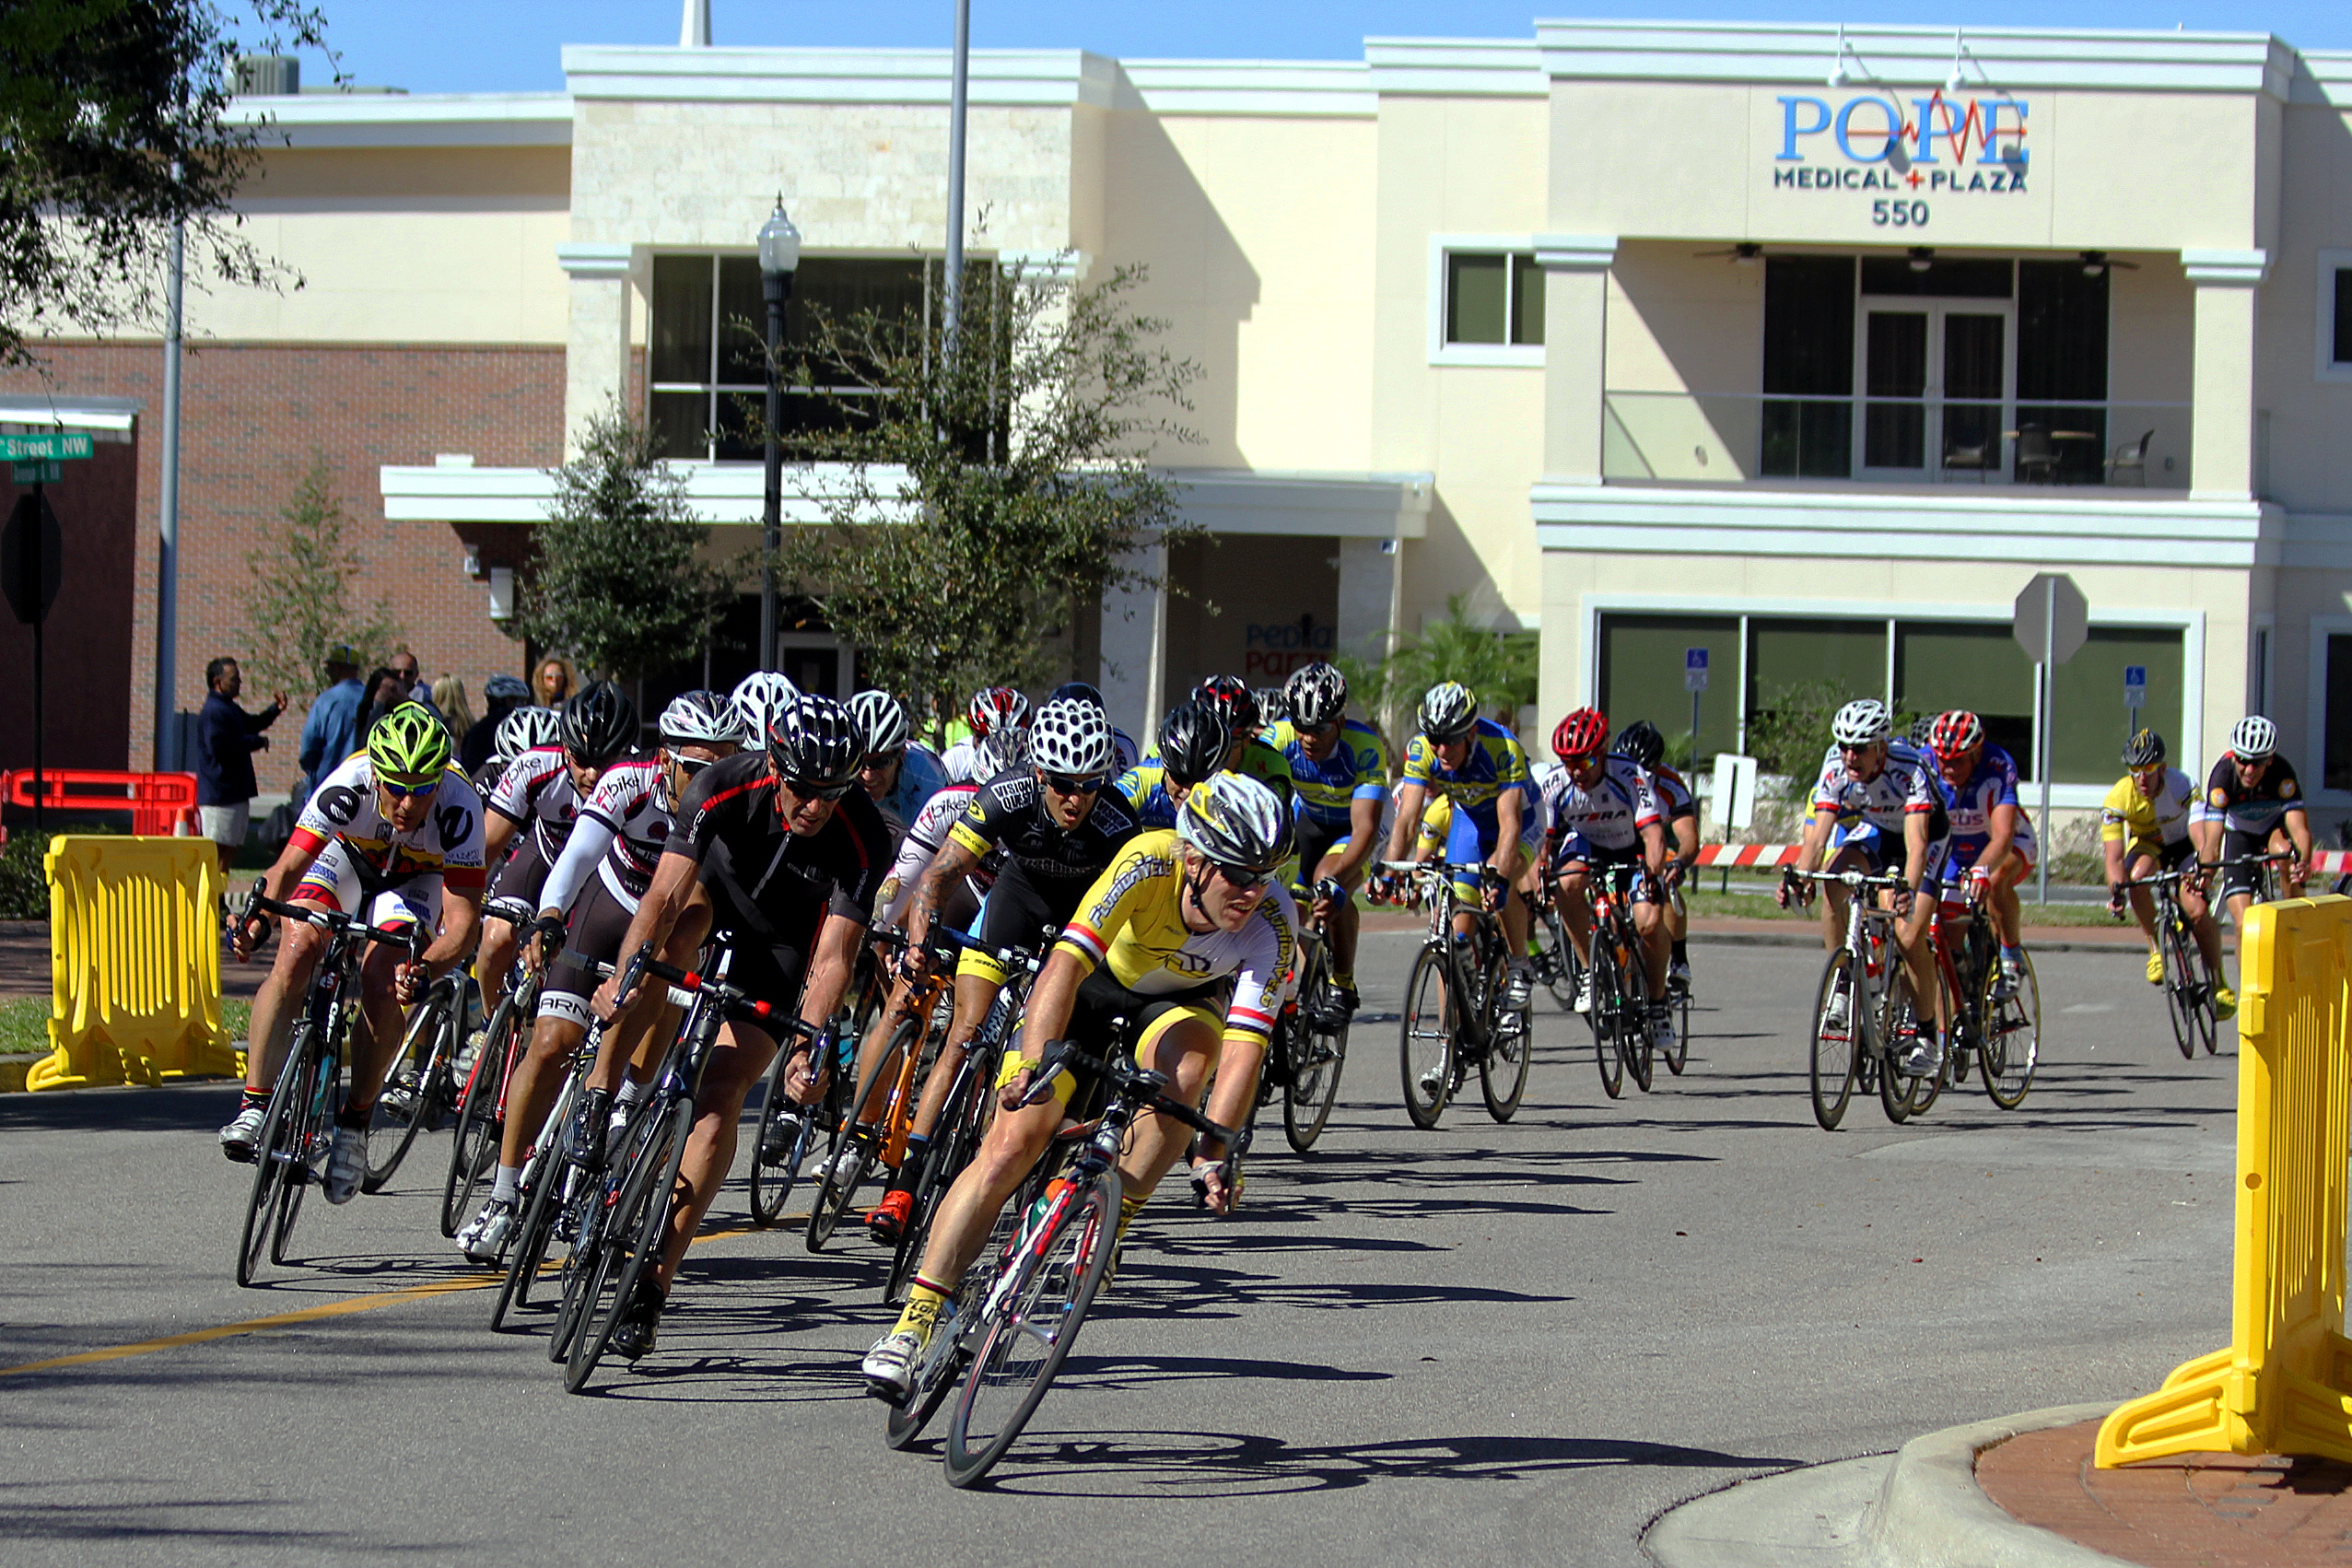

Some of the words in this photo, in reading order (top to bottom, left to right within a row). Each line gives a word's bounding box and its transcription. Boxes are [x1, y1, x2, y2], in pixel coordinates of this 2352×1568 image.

[1774, 94, 2030, 165] POPE
[1774, 167, 1900, 191] MEDICAL
[1931, 170, 2029, 193] PLAZA
[1872, 198, 1931, 228] 550
[6, 438, 53, 457] Street
[62, 437, 88, 455] NW
[993, 778, 1035, 798] VISION
[1001, 791, 1034, 812] QUEST
